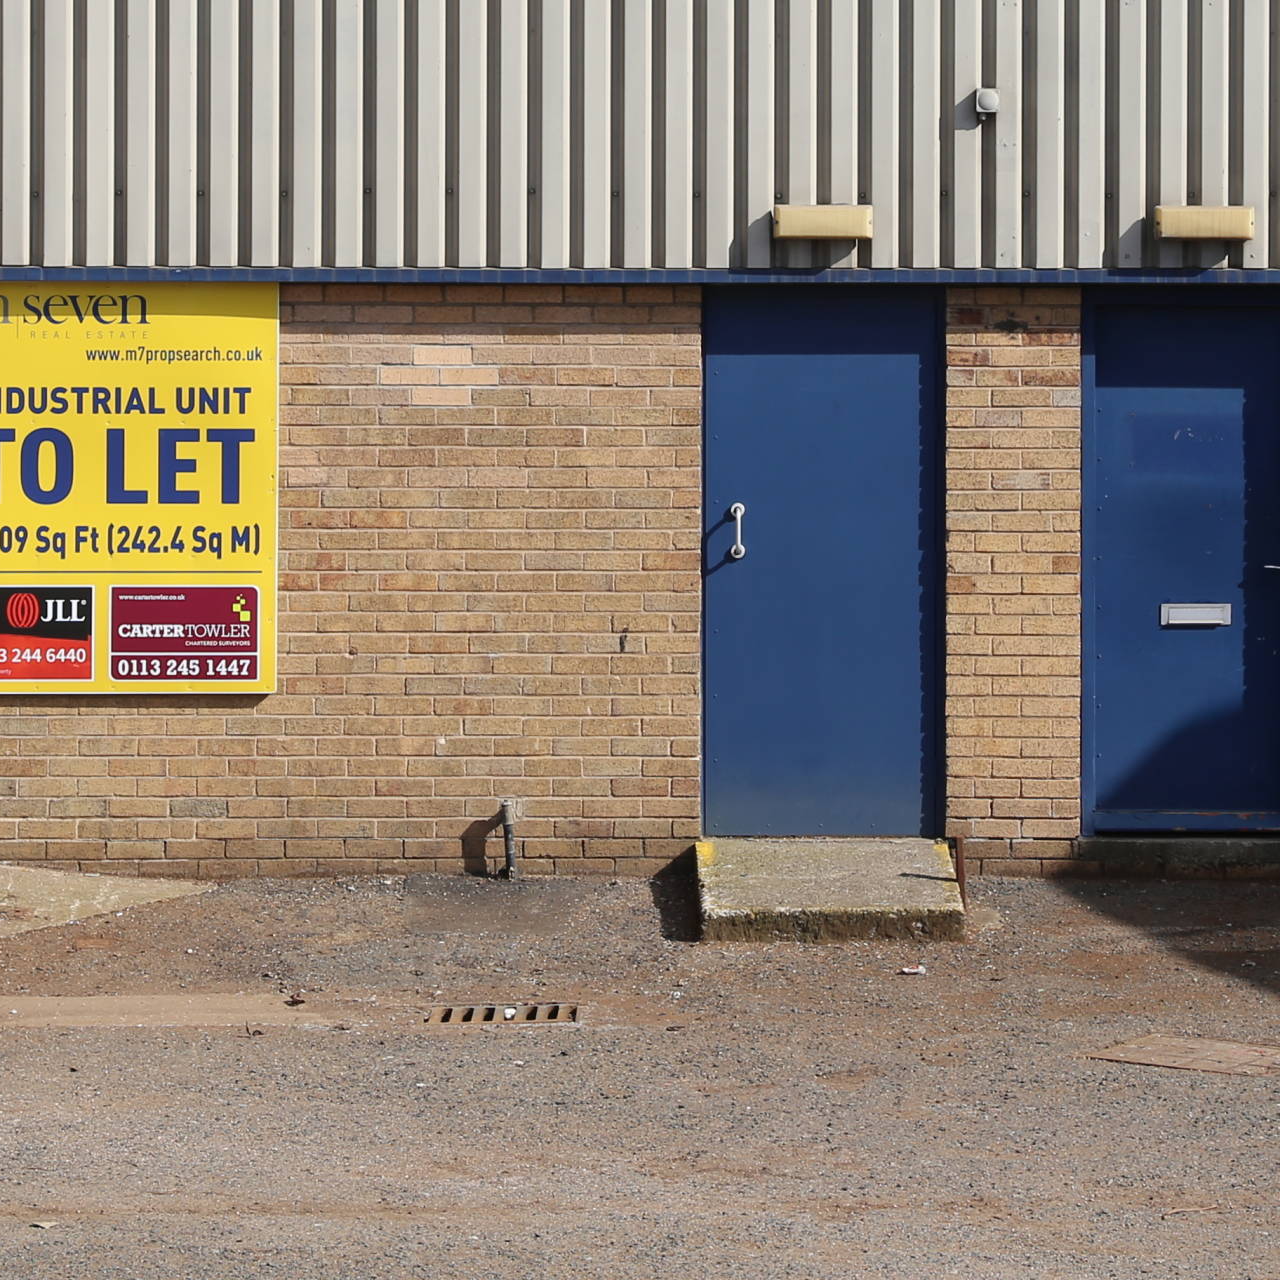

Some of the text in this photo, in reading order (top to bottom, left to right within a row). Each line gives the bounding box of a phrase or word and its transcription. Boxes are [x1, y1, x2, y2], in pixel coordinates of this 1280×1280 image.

[23, 294, 150, 325] seven
[30, 330, 149, 340] REAL ESTATE
[85, 346, 263, 365] www.m7propsearch.co.uk
[176, 387, 252, 414] UNIT
[106, 428, 256, 505] LET
[35, 525, 66, 560] Sq
[74, 526, 99, 554] Ft
[107, 523, 185, 556] (242.4
[191, 525, 222, 560] Sq
[231, 523, 260, 556] M)
[11, 648, 42, 663] 244
[46, 648, 87, 663] 6440
[118, 659, 251, 676] 0113 245 1447
